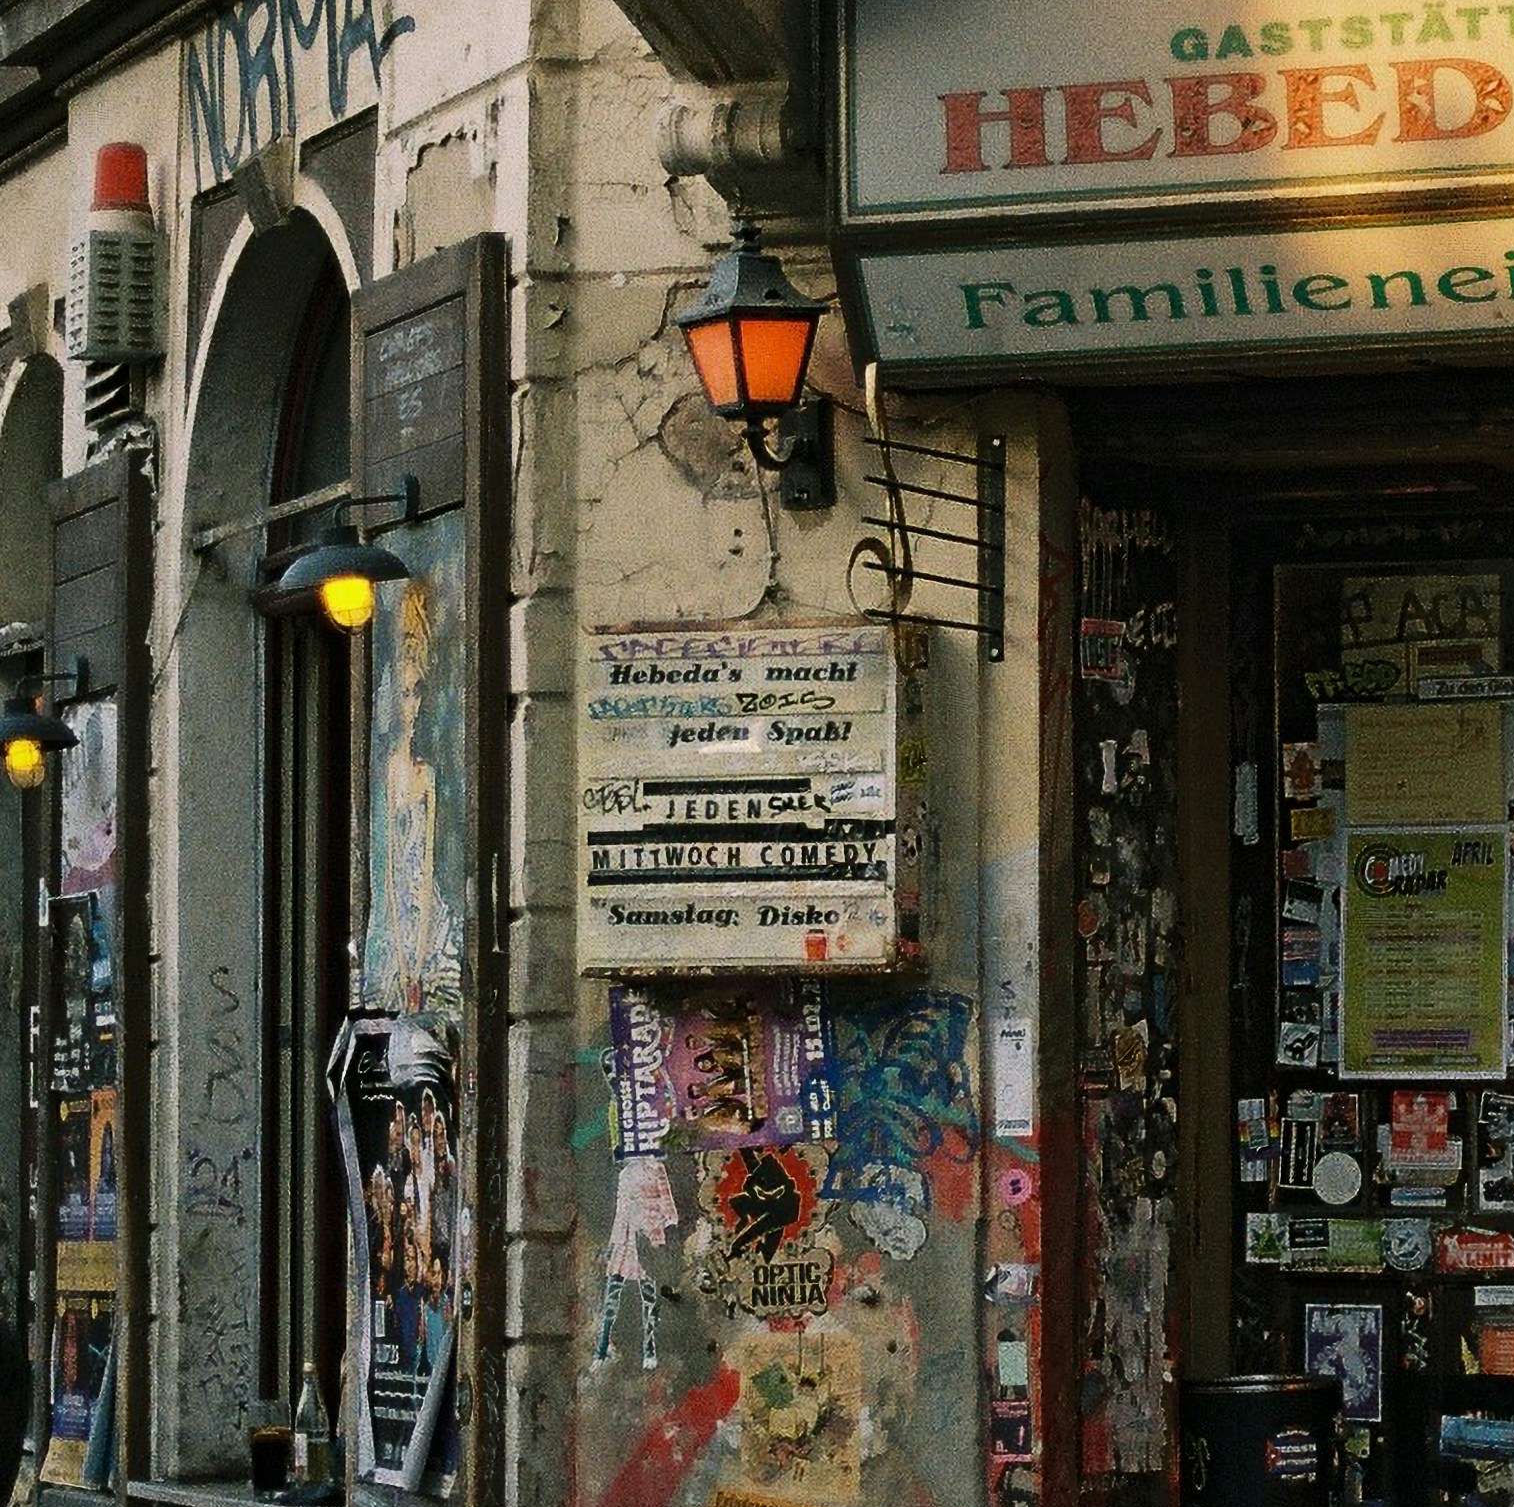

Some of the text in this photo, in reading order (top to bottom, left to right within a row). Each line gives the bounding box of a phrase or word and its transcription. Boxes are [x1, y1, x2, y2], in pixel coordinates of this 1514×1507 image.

[611, 661, 858, 686] Hebeda's macht
[668, 722, 750, 747] jeden
[666, 797, 762, 820] JEDEN
[593, 842, 876, 871] MITTWOCH COMEDY
[757, 905, 840, 927] Disko
[753, 1262, 822, 1285] OPTIC
[752, 1283, 826, 1306] NINJA
